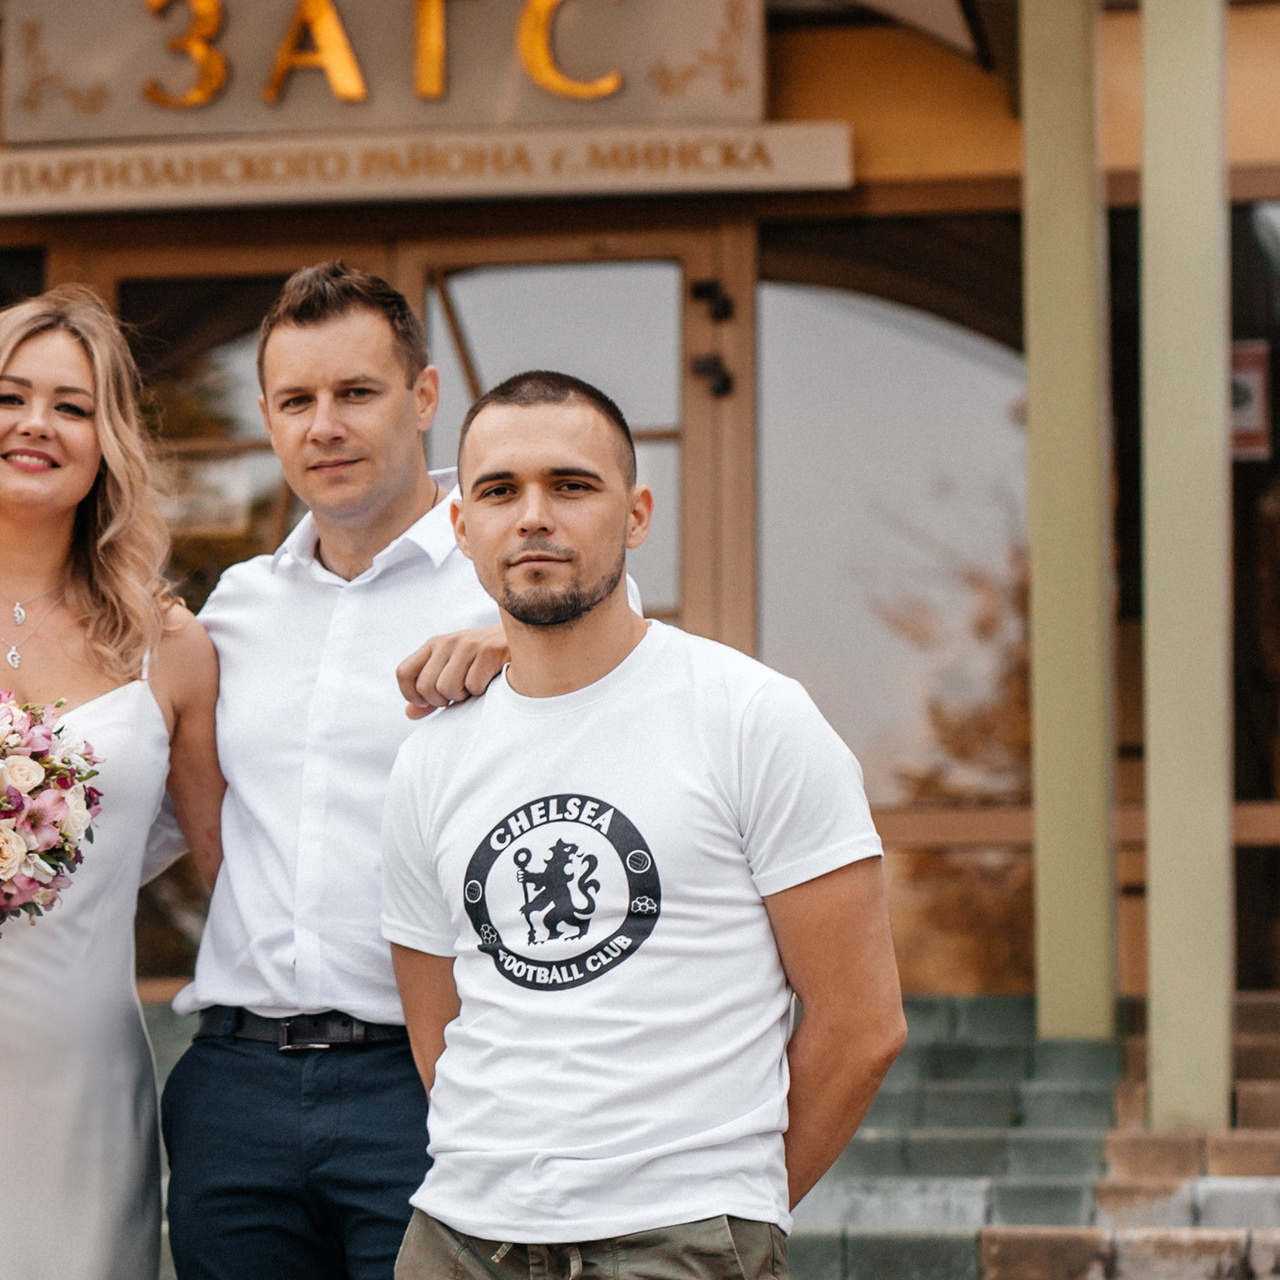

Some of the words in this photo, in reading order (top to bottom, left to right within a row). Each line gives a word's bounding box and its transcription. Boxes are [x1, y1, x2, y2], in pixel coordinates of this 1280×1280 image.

[0, 148, 351, 194] ПАРТИЗАНСКОГО
[360, 141, 534, 178] РАЙОНА
[490, 797, 615, 851] CHELSEA
[498, 949, 584, 985] FOOTBALL
[585, 935, 633, 972] CLUB
